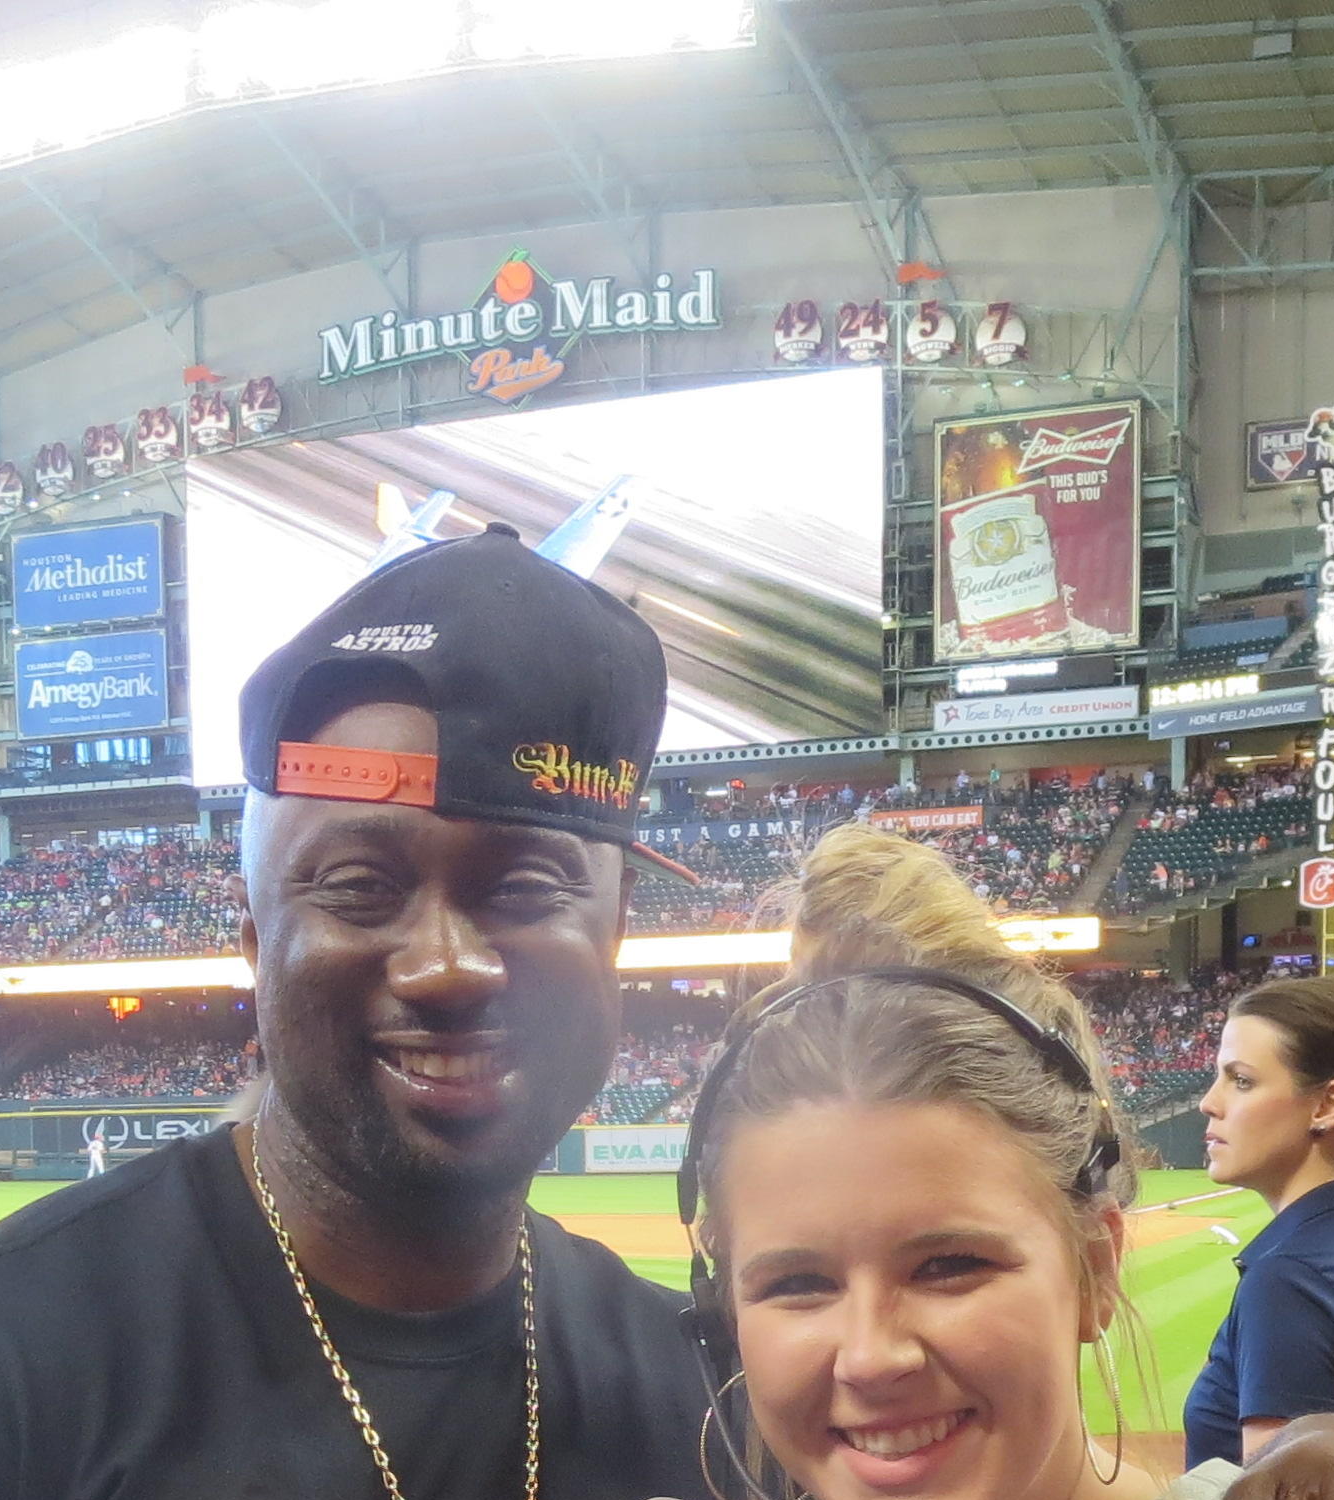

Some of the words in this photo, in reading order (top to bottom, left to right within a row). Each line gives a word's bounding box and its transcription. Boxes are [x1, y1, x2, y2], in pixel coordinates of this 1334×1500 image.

[319, 294, 539, 378] Minute
[552, 269, 717, 331] Maid
[775, 300, 816, 338] 49
[839, 299, 883, 339] 24
[919, 300, 940, 338] 5
[987, 301, 1011, 340] 7
[468, 347, 563, 400] Park
[189, 391, 225, 425] 34
[137, 407, 169, 441] 33
[1019, 434, 1124, 458] Budweiser
[1262, 432, 1304, 449] MLB
[1049, 474, 1073, 488] THIS
[1077, 470, 1108, 486] BUD'S
[1056, 489, 1078, 503] FOR
[1080, 487, 1100, 501] YOU
[23, 554, 73, 567] HOUSTON
[25, 555, 148, 592] Methodist
[58, 590, 98, 602] LEADING
[102, 586, 148, 598] MEDICINE
[331, 633, 439, 652] ASTROS
[358, 624, 434, 637] HOUSTON
[964, 703, 990, 721] Texas
[993, 703, 1015, 723] Bay
[1018, 699, 1044, 716] Area
[1049, 702, 1090, 715] CREDIT
[1092, 700, 1133, 713] UNION
[1189, 711, 1217, 725] HOME
[1219, 709, 1245, 723] FIELD
[1247, 701, 1307, 719] ADVANTAGE
[909, 816, 931, 829] YOU
[932, 814, 955, 827] CAN
[957, 812, 979, 826] EAT
[592, 1144, 647, 1160] EVA
